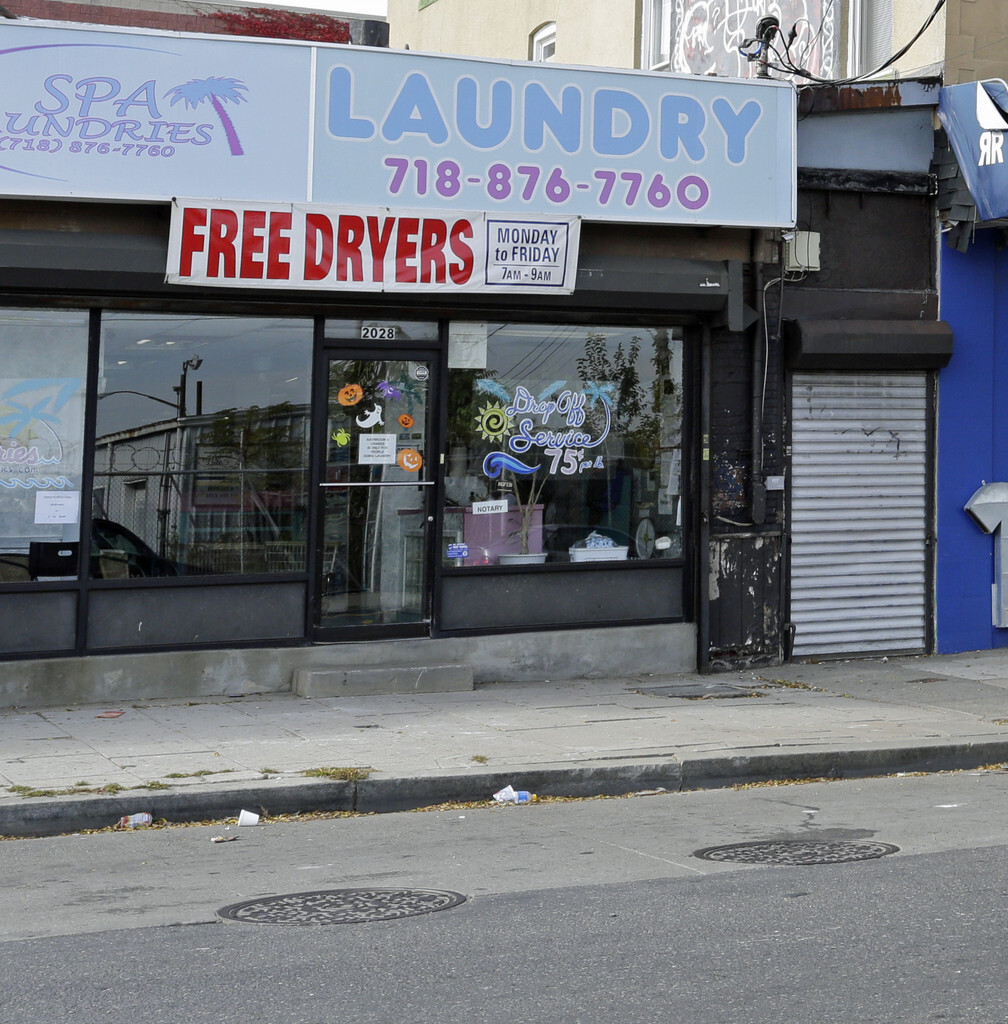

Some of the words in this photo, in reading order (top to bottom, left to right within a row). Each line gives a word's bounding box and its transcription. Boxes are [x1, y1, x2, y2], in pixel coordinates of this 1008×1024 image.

[34, 74, 162, 119] SPA
[0, 112, 214, 146] UNDRIES
[327, 66, 762, 165] LAUNDRY
[0, 136, 62, 153] (718)
[68, 140, 176, 158] 876-7760
[383, 157, 710, 211] 718-876-7760
[179, 207, 293, 280] FREE
[303, 212, 474, 286] DRYERS
[497, 227, 558, 245] MONDAY
[495, 247, 508, 262] to
[512, 246, 560, 263] FRIDAY
[502, 267, 522, 280] 7AM
[530, 267, 552, 281] 9AM
[362, 327, 396, 339] 2028
[505, 386, 557, 425] Drop
[556, 390, 587, 427] Off
[508, 418, 593, 454] Service
[477, 504, 504, 513] NOTARY
